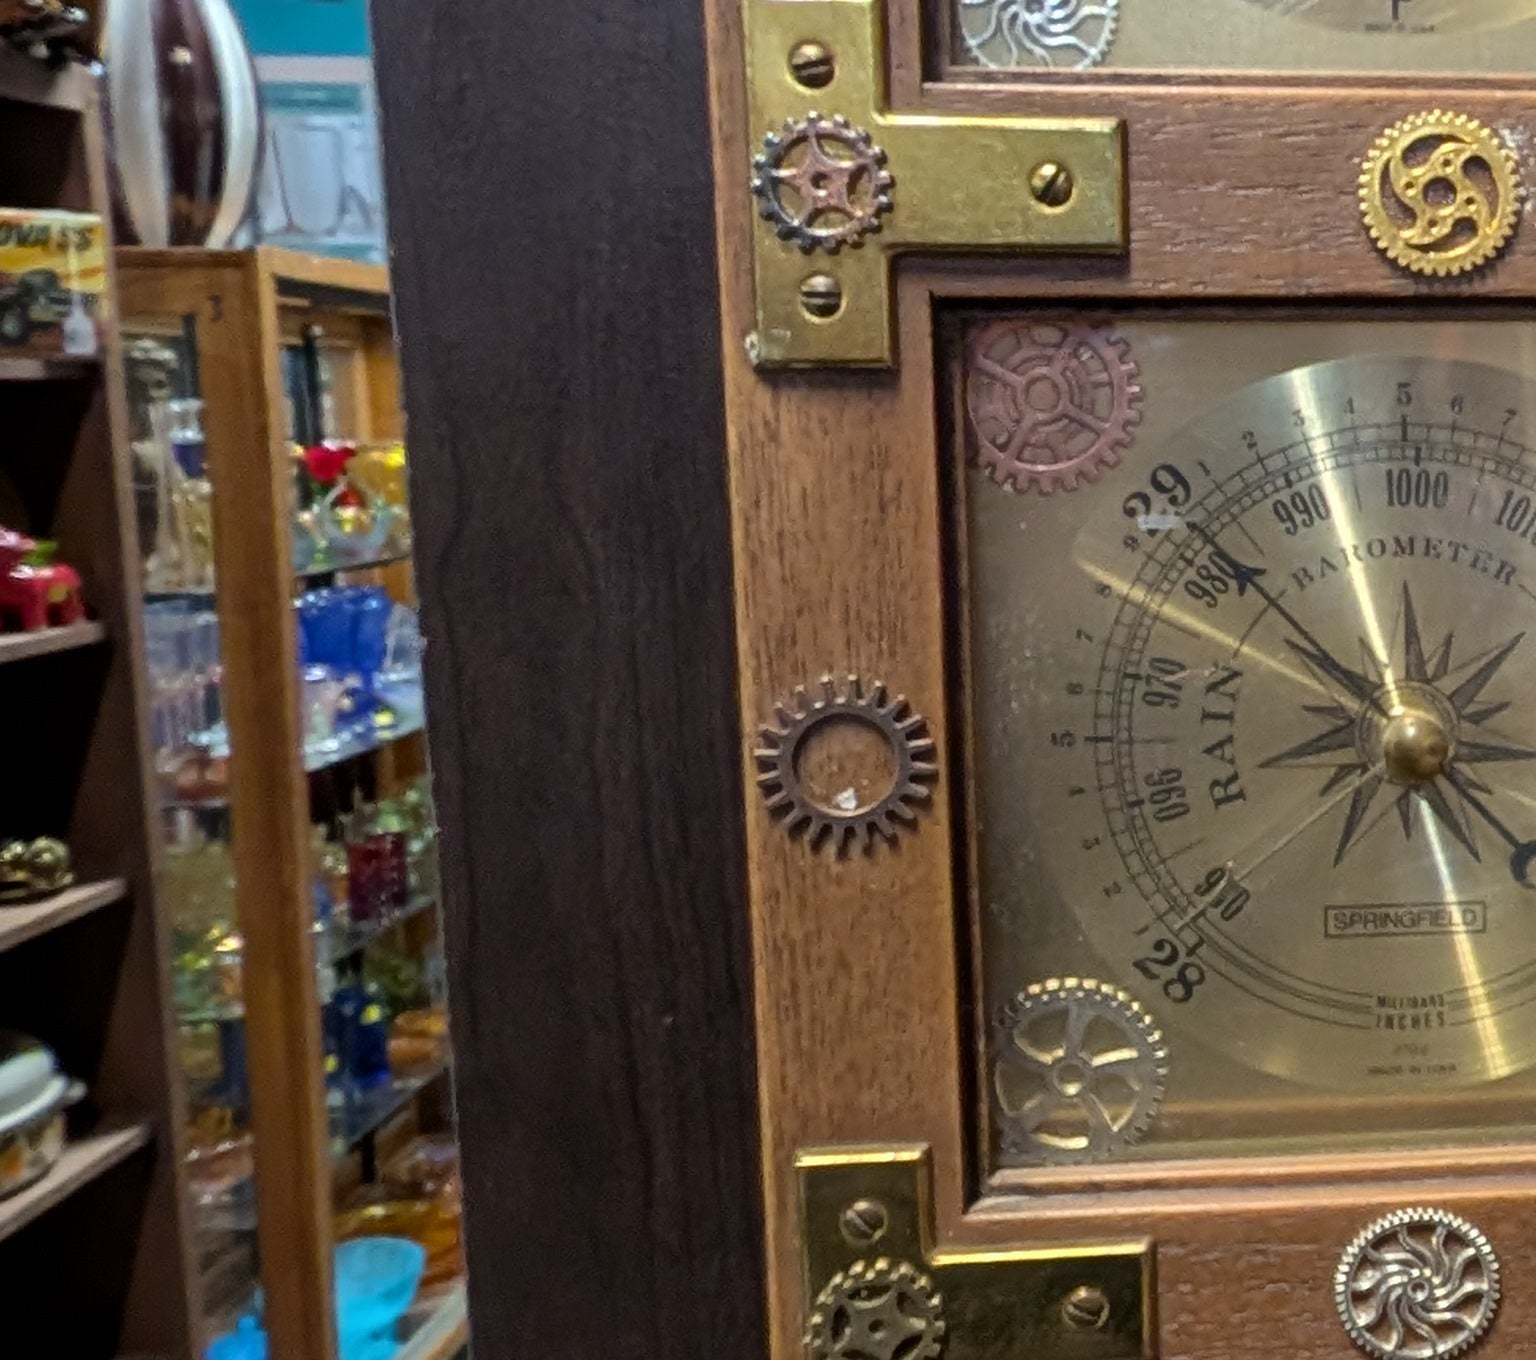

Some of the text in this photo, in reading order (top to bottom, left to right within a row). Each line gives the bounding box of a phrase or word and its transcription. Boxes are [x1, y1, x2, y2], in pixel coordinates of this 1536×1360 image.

[1122, 462, 1192, 539] 29
[1272, 482, 1331, 536] 990
[1385, 467, 1449, 509] 1000
[1184, 550, 1238, 609] 980
[1290, 535, 1517, 592] BAROMETER
[1141, 657, 1188, 710] 970
[1201, 660, 1247, 810] RAIN
[1143, 767, 1191, 822] 960
[1332, 908, 1478, 932] SPRINGFIELD
[1131, 938, 1207, 1005] 28
